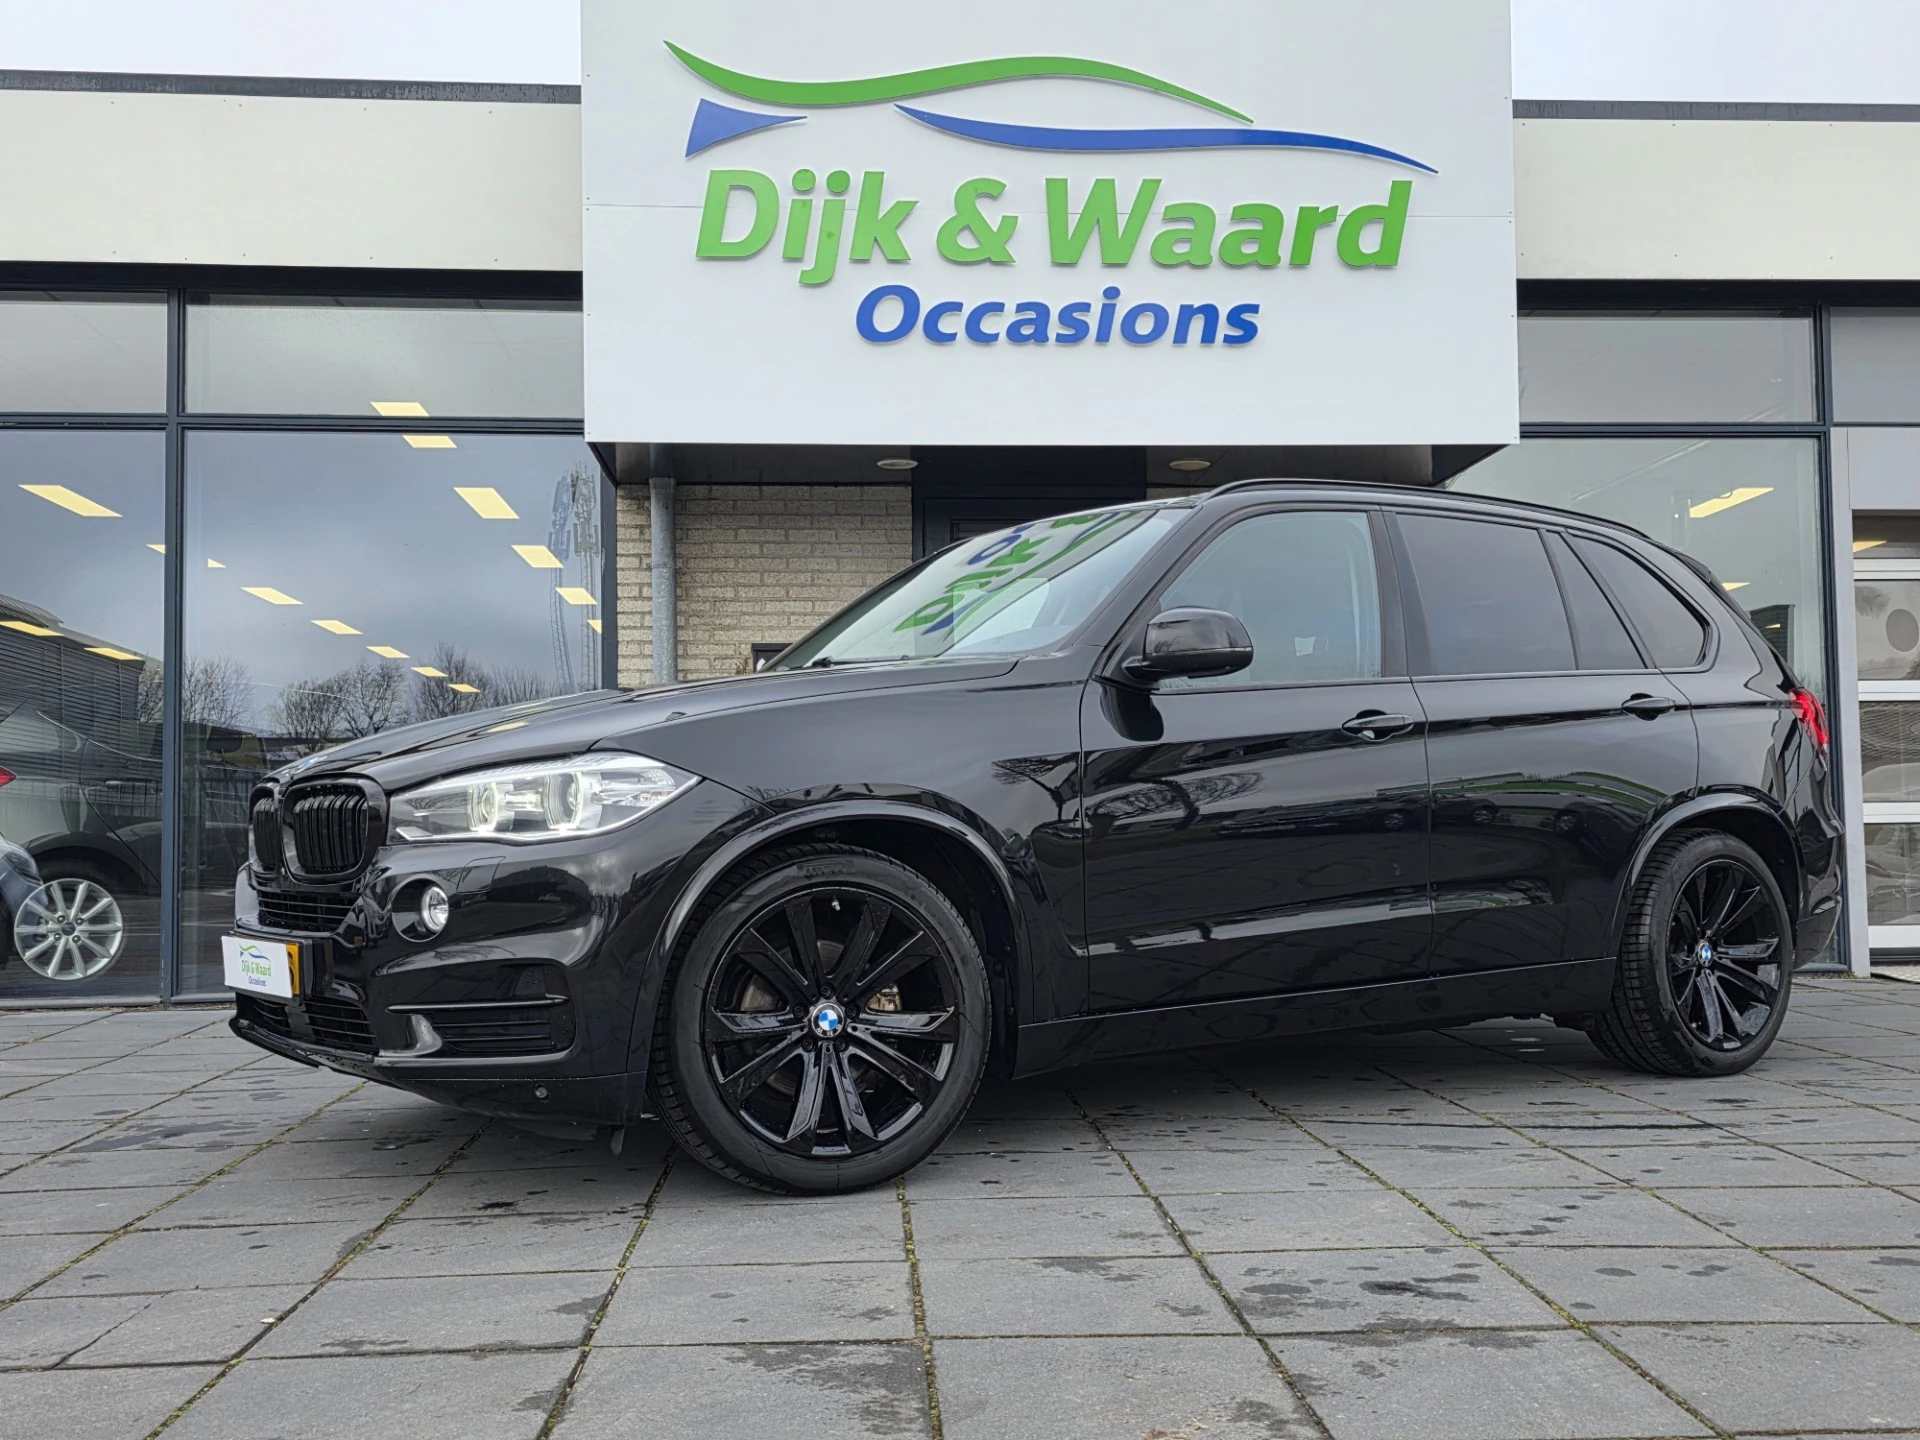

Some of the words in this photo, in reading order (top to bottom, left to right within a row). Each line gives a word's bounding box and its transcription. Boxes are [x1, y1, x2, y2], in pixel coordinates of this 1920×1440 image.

[695, 168, 917, 285] Dijk
[936, 178, 1018, 265] &
[1045, 179, 1413, 268] Waard
[855, 284, 1261, 345] Occasions
